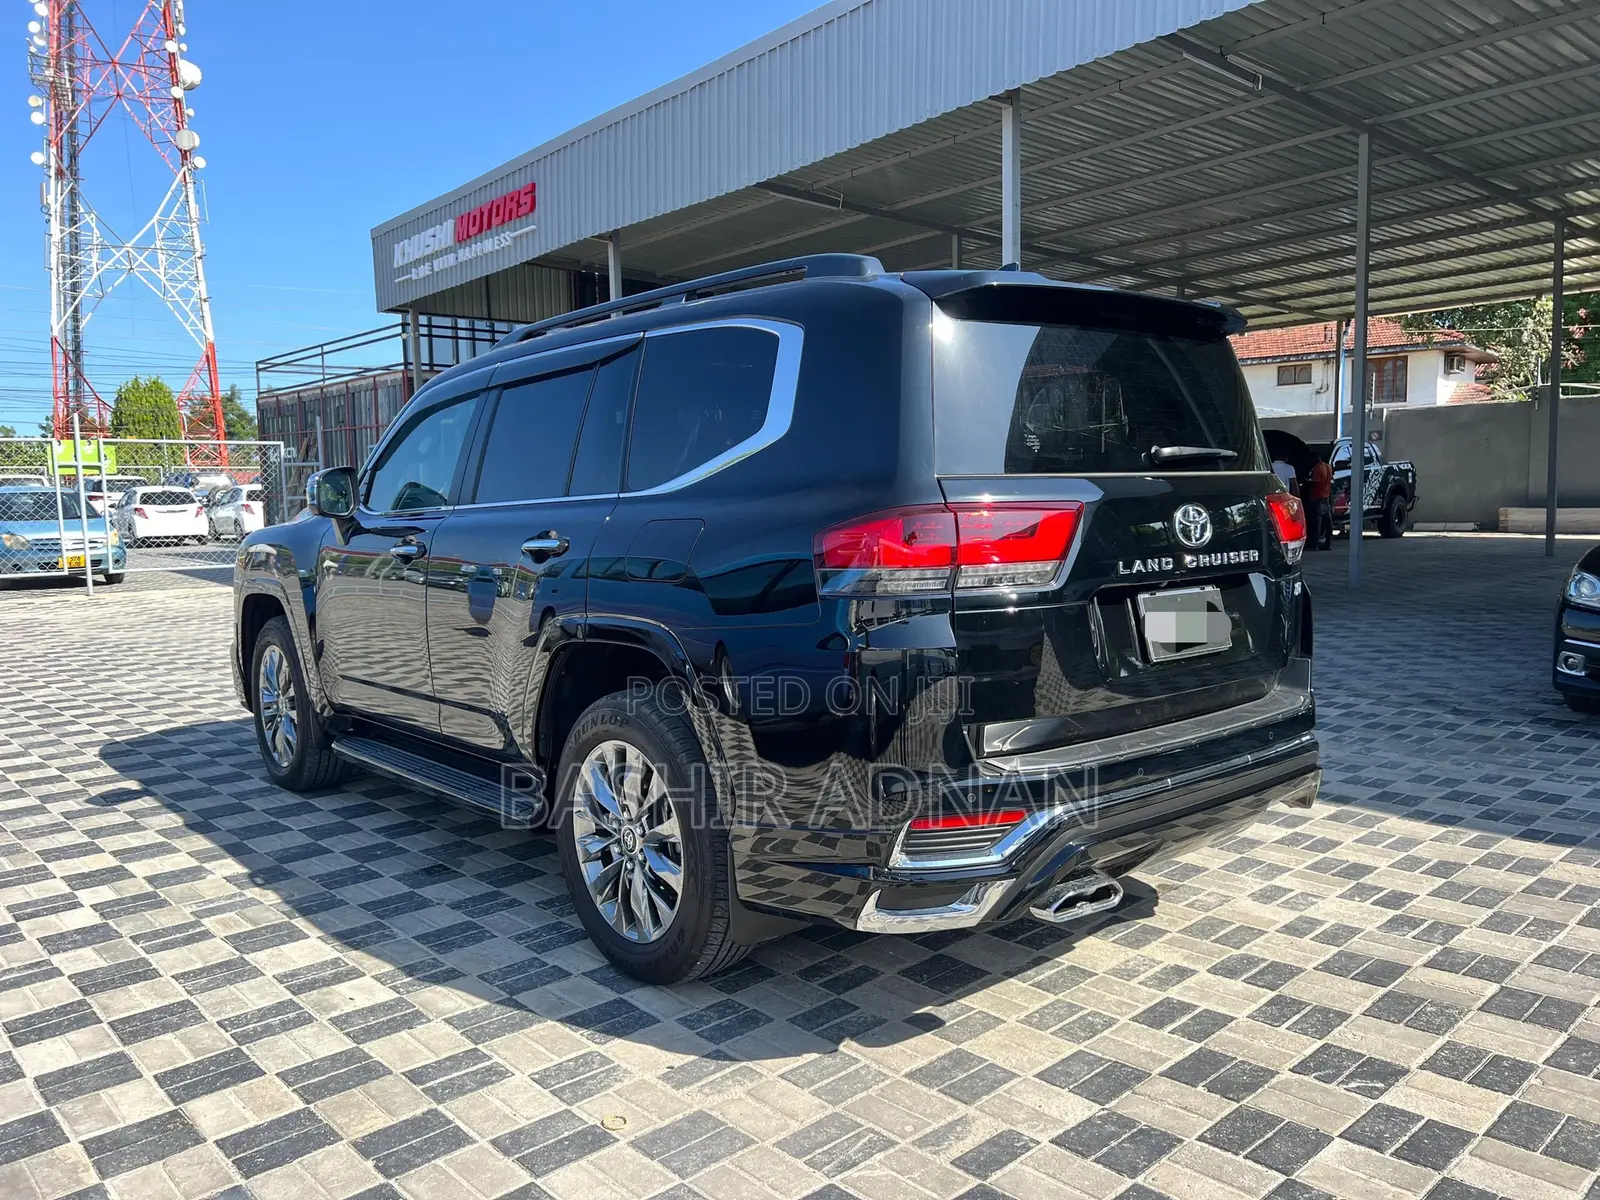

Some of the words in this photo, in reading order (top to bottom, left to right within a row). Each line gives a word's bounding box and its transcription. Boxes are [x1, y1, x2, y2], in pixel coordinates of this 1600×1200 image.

[394, 218, 456, 268] KHUSHI
[455, 181, 536, 243] MOTORS
[457, 231, 513, 262] HAPPINESS
[1118, 557, 1174, 575] LAND
[1183, 549, 1259, 569] CRUISER
[573, 714, 629, 743] DUNLOP
